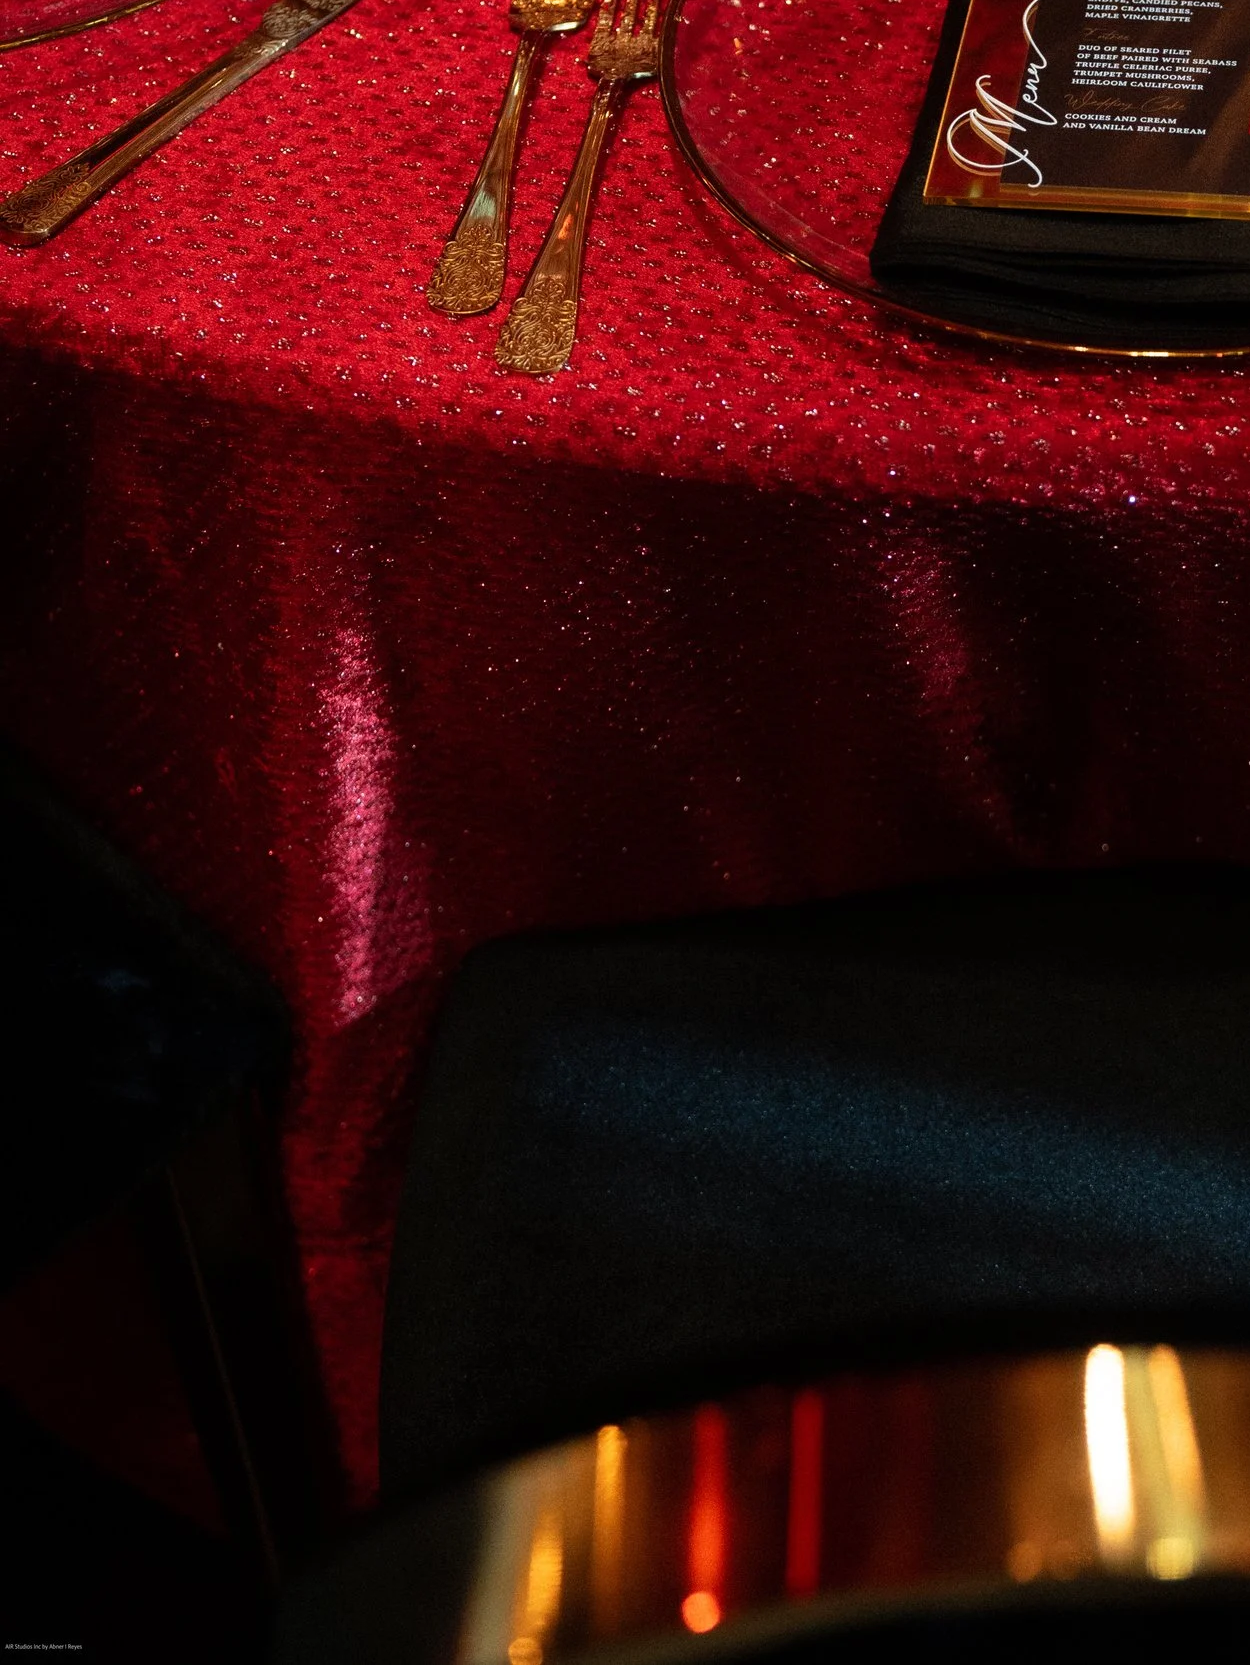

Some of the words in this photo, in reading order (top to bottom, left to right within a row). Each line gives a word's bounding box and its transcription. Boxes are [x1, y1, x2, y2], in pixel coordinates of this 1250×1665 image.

[1121, 6, 1194, 15] CRANBERRIES,
[1180, 0, 1223, 9] PECANS,
[1122, 14, 1191, 23] VINAIGRETTE
[1078, 44, 1101, 52] DUO
[1120, 46, 1160, 54] SEARED
[1162, 48, 1192, 56] FILET
[1093, 53, 1118, 61] BEEF
[1121, 55, 1159, 63] PAIRED
[1192, 58, 1238, 67] SEABASS
[1075, 61, 1120, 69] TRUFFLE
[1122, 63, 1173, 72] CELERIAC
[1175, 66, 1211, 74] PUREE,
[1073, 69, 1123, 78] TRUMPET
[1125, 71, 1195, 82] MUSHROOMS,
[1071, 78, 1128, 87] HEIRLOOM
[1130, 81, 1204, 91] CAULIFLOWER
[1065, 113, 1111, 121] COOKIES
[1140, 116, 1177, 124] CREAM
[1088, 123, 1134, 132] VANILLA
[1137, 125, 1166, 133] BEAN
[1168, 127, 1206, 135] DREAM
